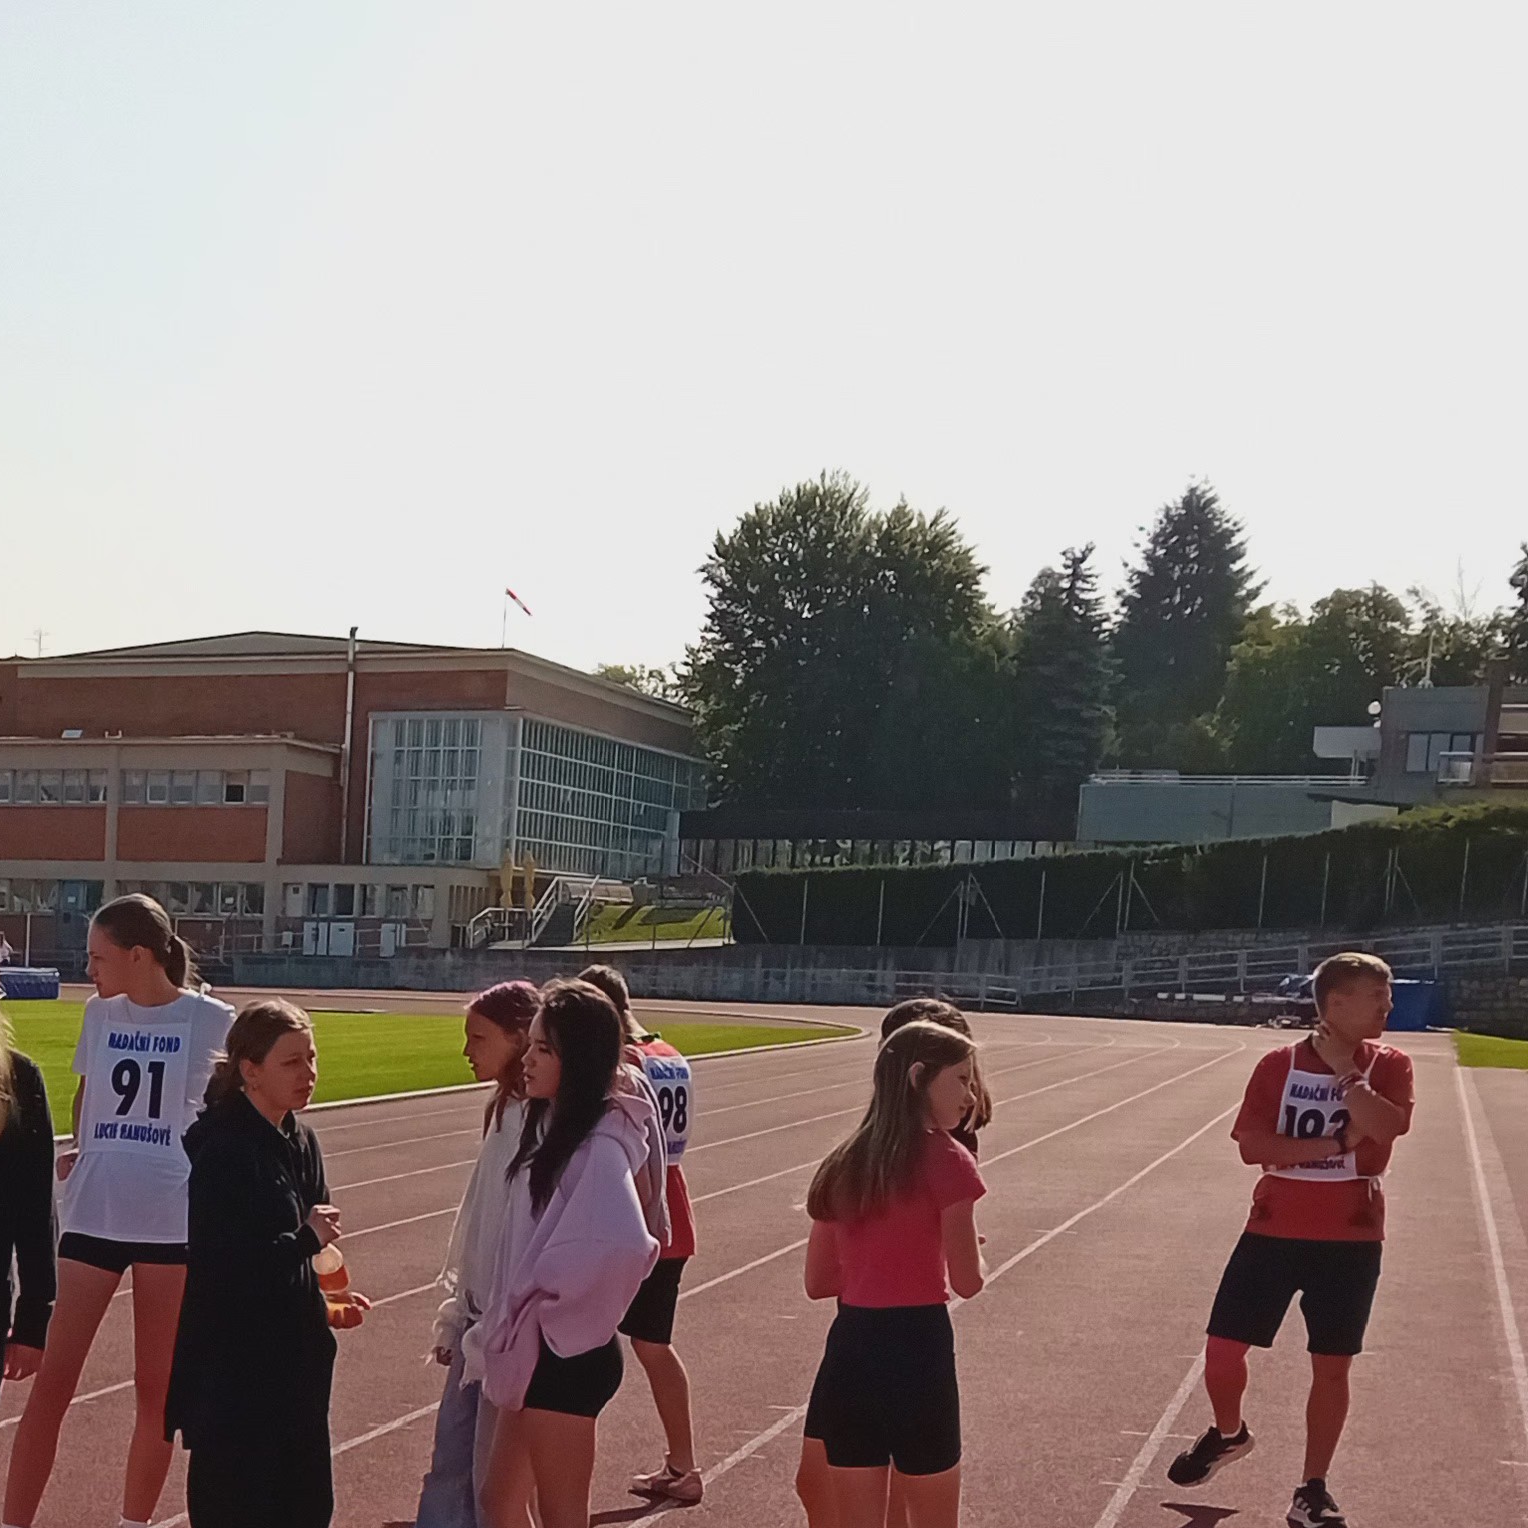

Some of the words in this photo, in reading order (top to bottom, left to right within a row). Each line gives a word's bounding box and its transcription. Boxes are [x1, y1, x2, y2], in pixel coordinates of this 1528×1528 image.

[152, 1036, 181, 1053] FOND
[112, 1058, 166, 1119] 91
[658, 1086, 687, 1134] 98
